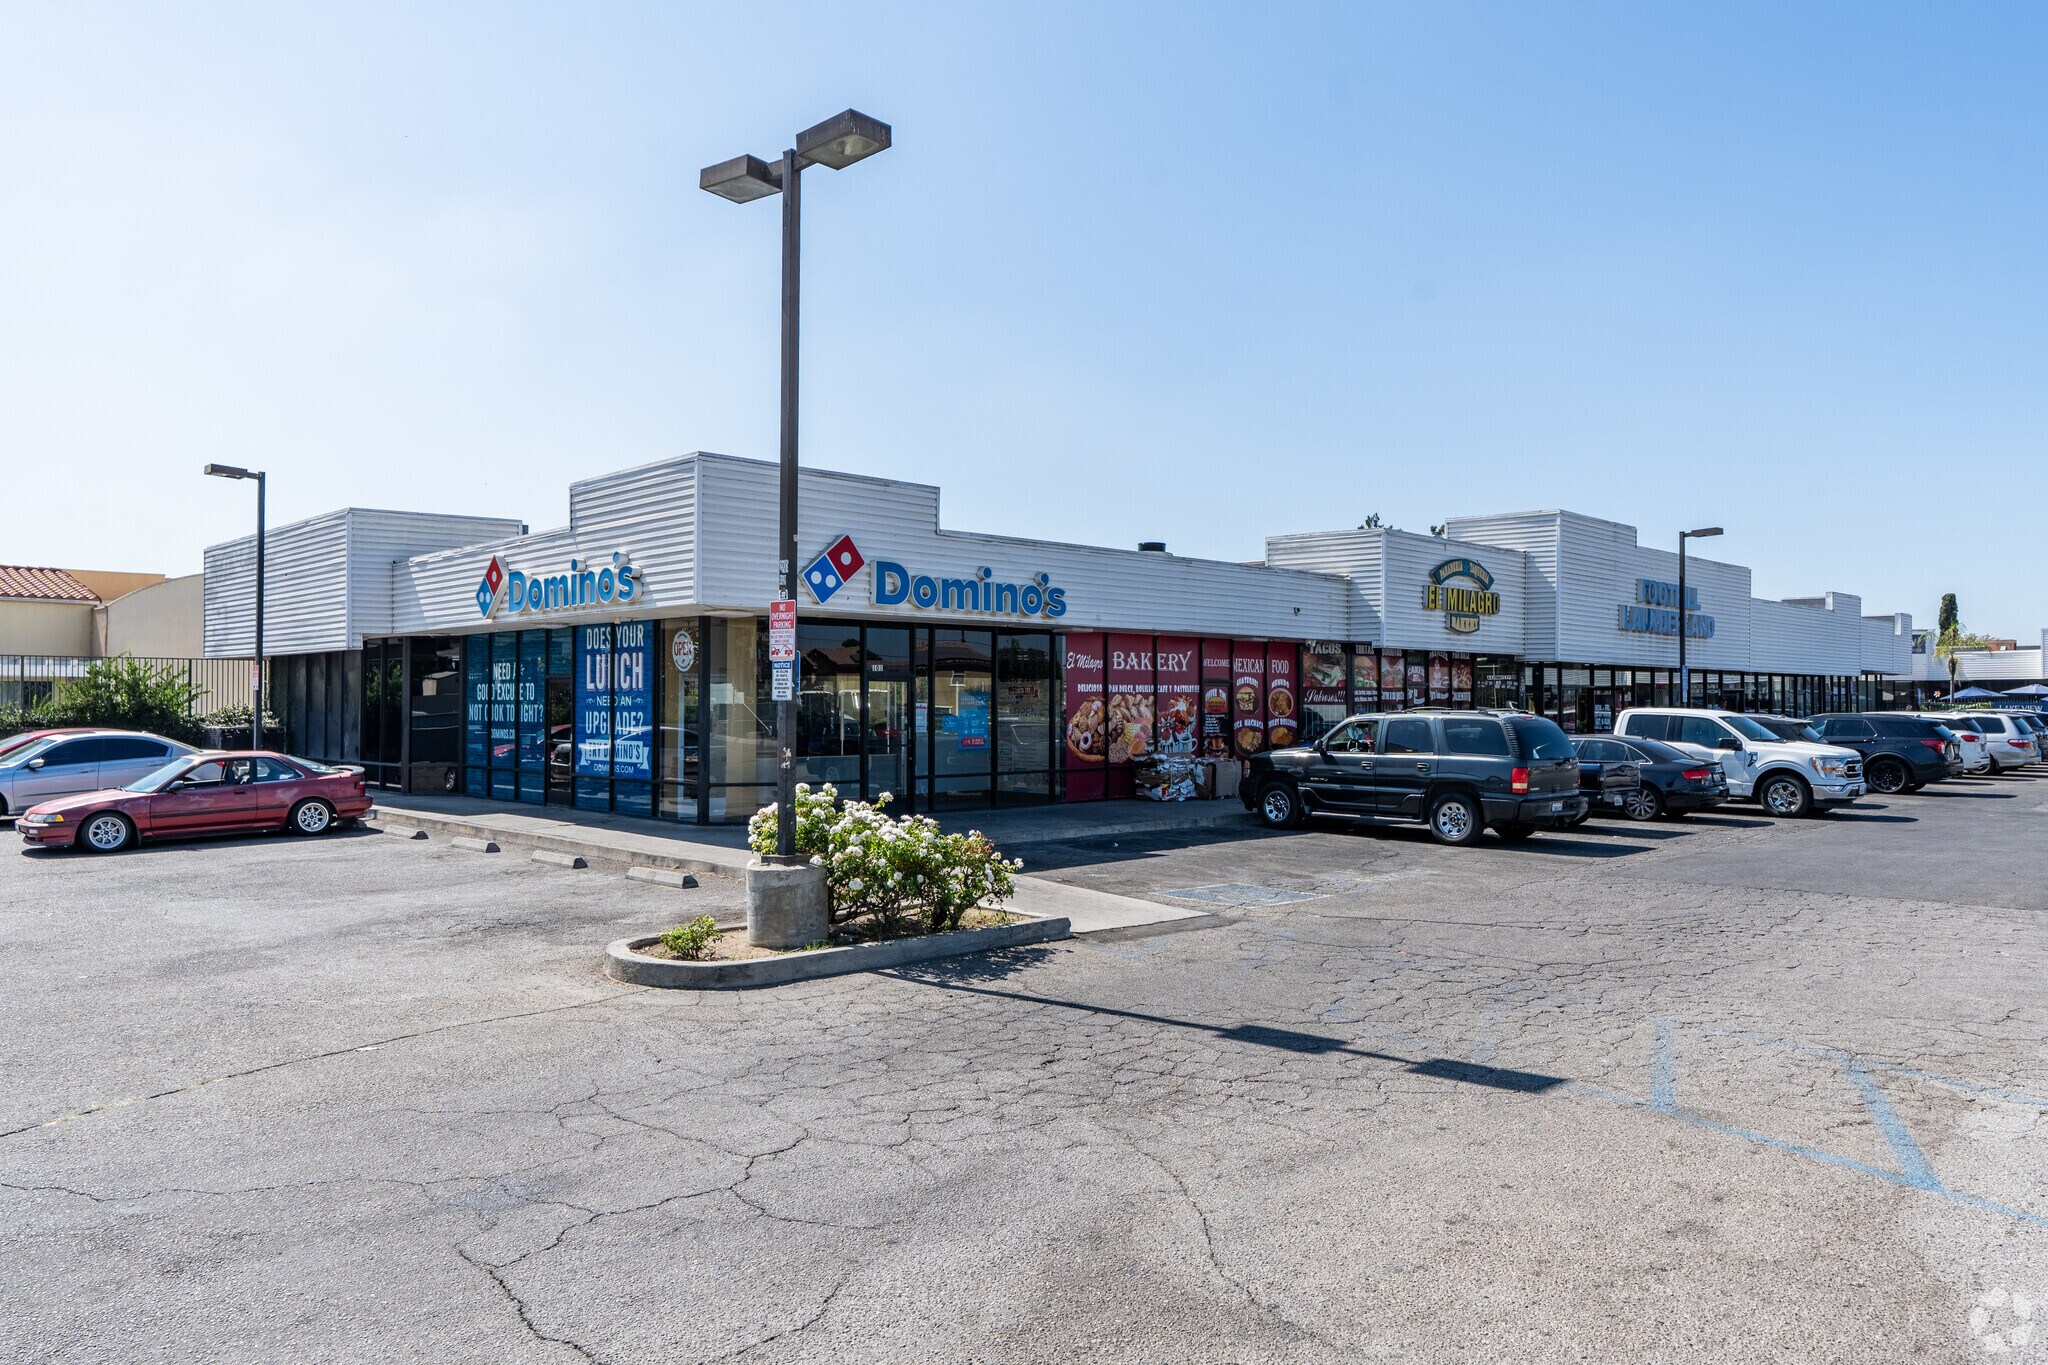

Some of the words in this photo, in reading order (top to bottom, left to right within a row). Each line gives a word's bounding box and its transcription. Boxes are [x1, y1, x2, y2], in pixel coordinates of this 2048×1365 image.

[508, 551, 641, 613] Domino's
[871, 561, 1067, 618] Domino's
[1428, 585, 1442, 609] EL
[1447, 587, 1500, 614] MILAGRO
[771, 612, 794, 620] OVERNIGHT
[1451, 616, 1479, 631] BAKERY
[586, 627, 611, 650] DOES
[616, 624, 644, 648] YOUR
[674, 642, 692, 656] OPEN
[1308, 642, 1342, 654] TACOS
[1066, 651, 1076, 669] El
[1112, 650, 1193, 672] BAKERY
[1272, 660, 1289, 674] FOOD
[493, 662, 512, 680] NEED
[497, 683, 524, 700] EXCUE
[526, 683, 535, 700] TO
[1077, 683, 1103, 693] DELICIOSO
[1108, 685, 1118, 693] PAN
[620, 697, 632, 707] AN
[468, 704, 483, 721] NOT
[506, 704, 544, 722] TOIGHT?
[603, 742, 641, 760] DMINO'S
